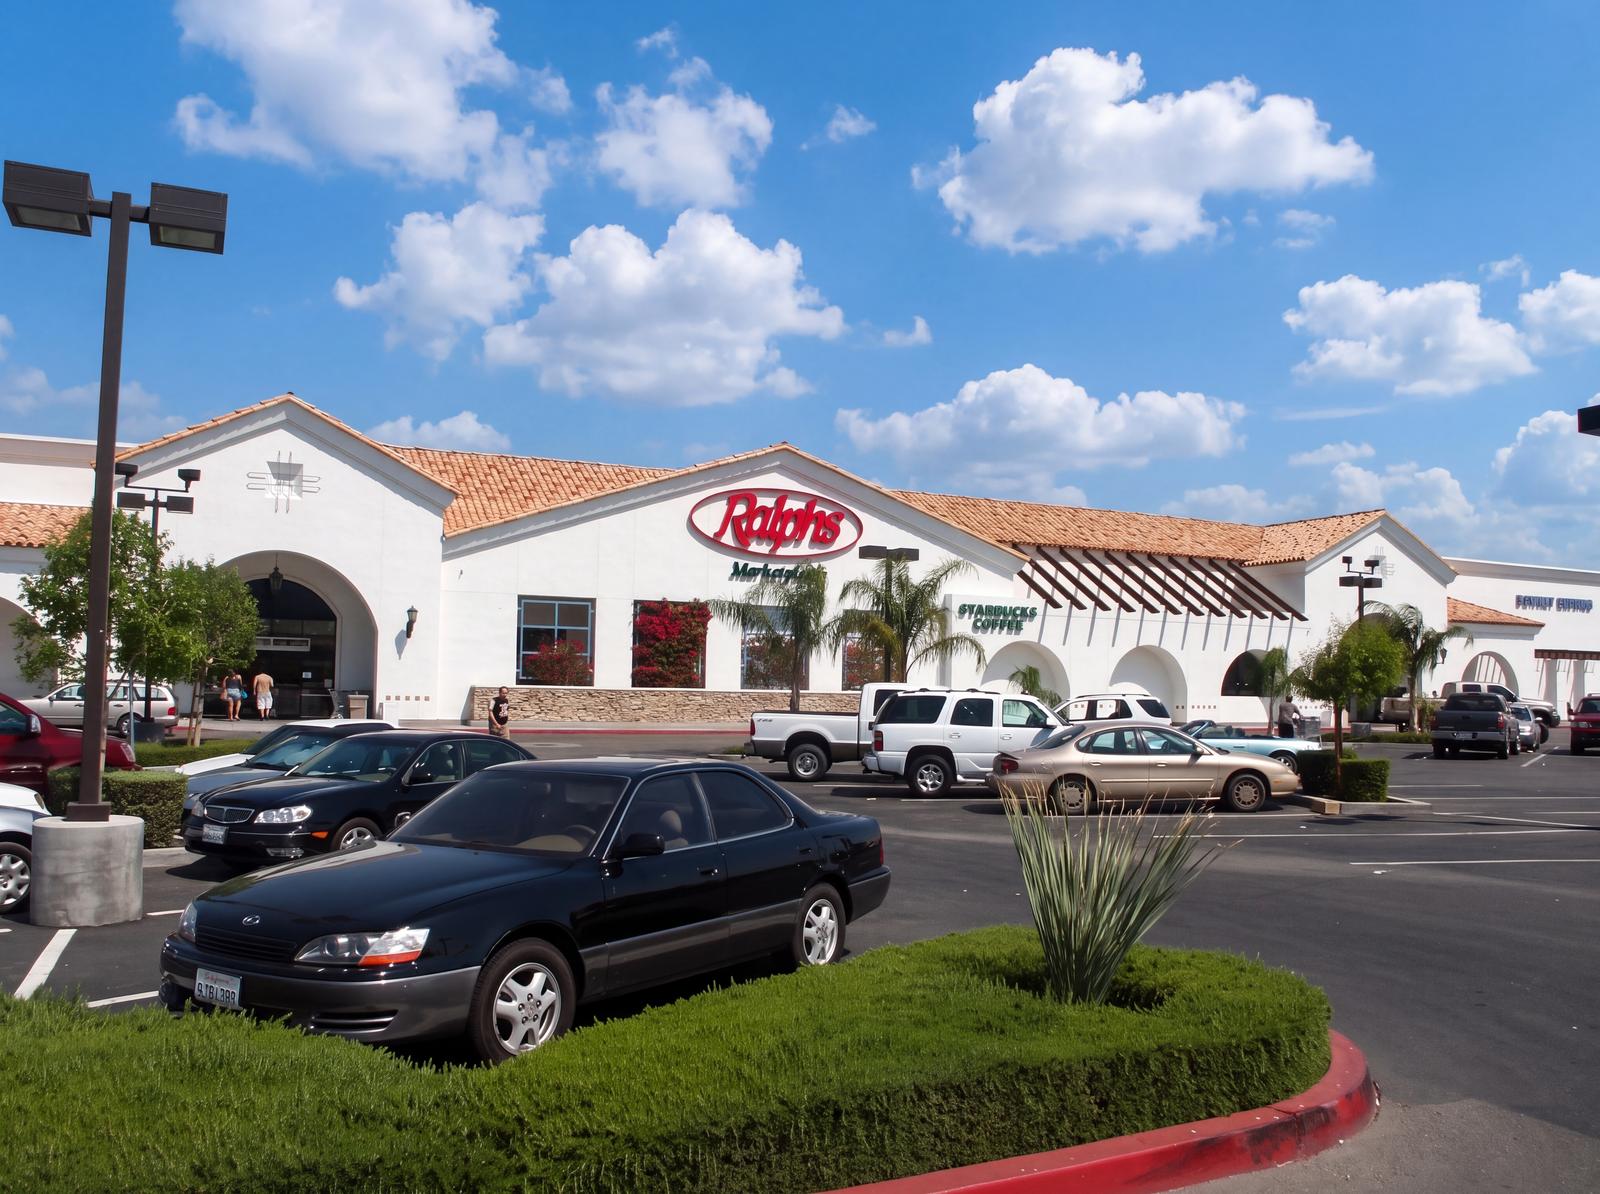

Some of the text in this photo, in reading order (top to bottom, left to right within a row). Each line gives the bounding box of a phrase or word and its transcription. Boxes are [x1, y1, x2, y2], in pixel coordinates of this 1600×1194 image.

[713, 492, 845, 554] Ralphs
[958, 603, 1037, 618] STARBUCKS
[973, 618, 1024, 630] COFFEE
